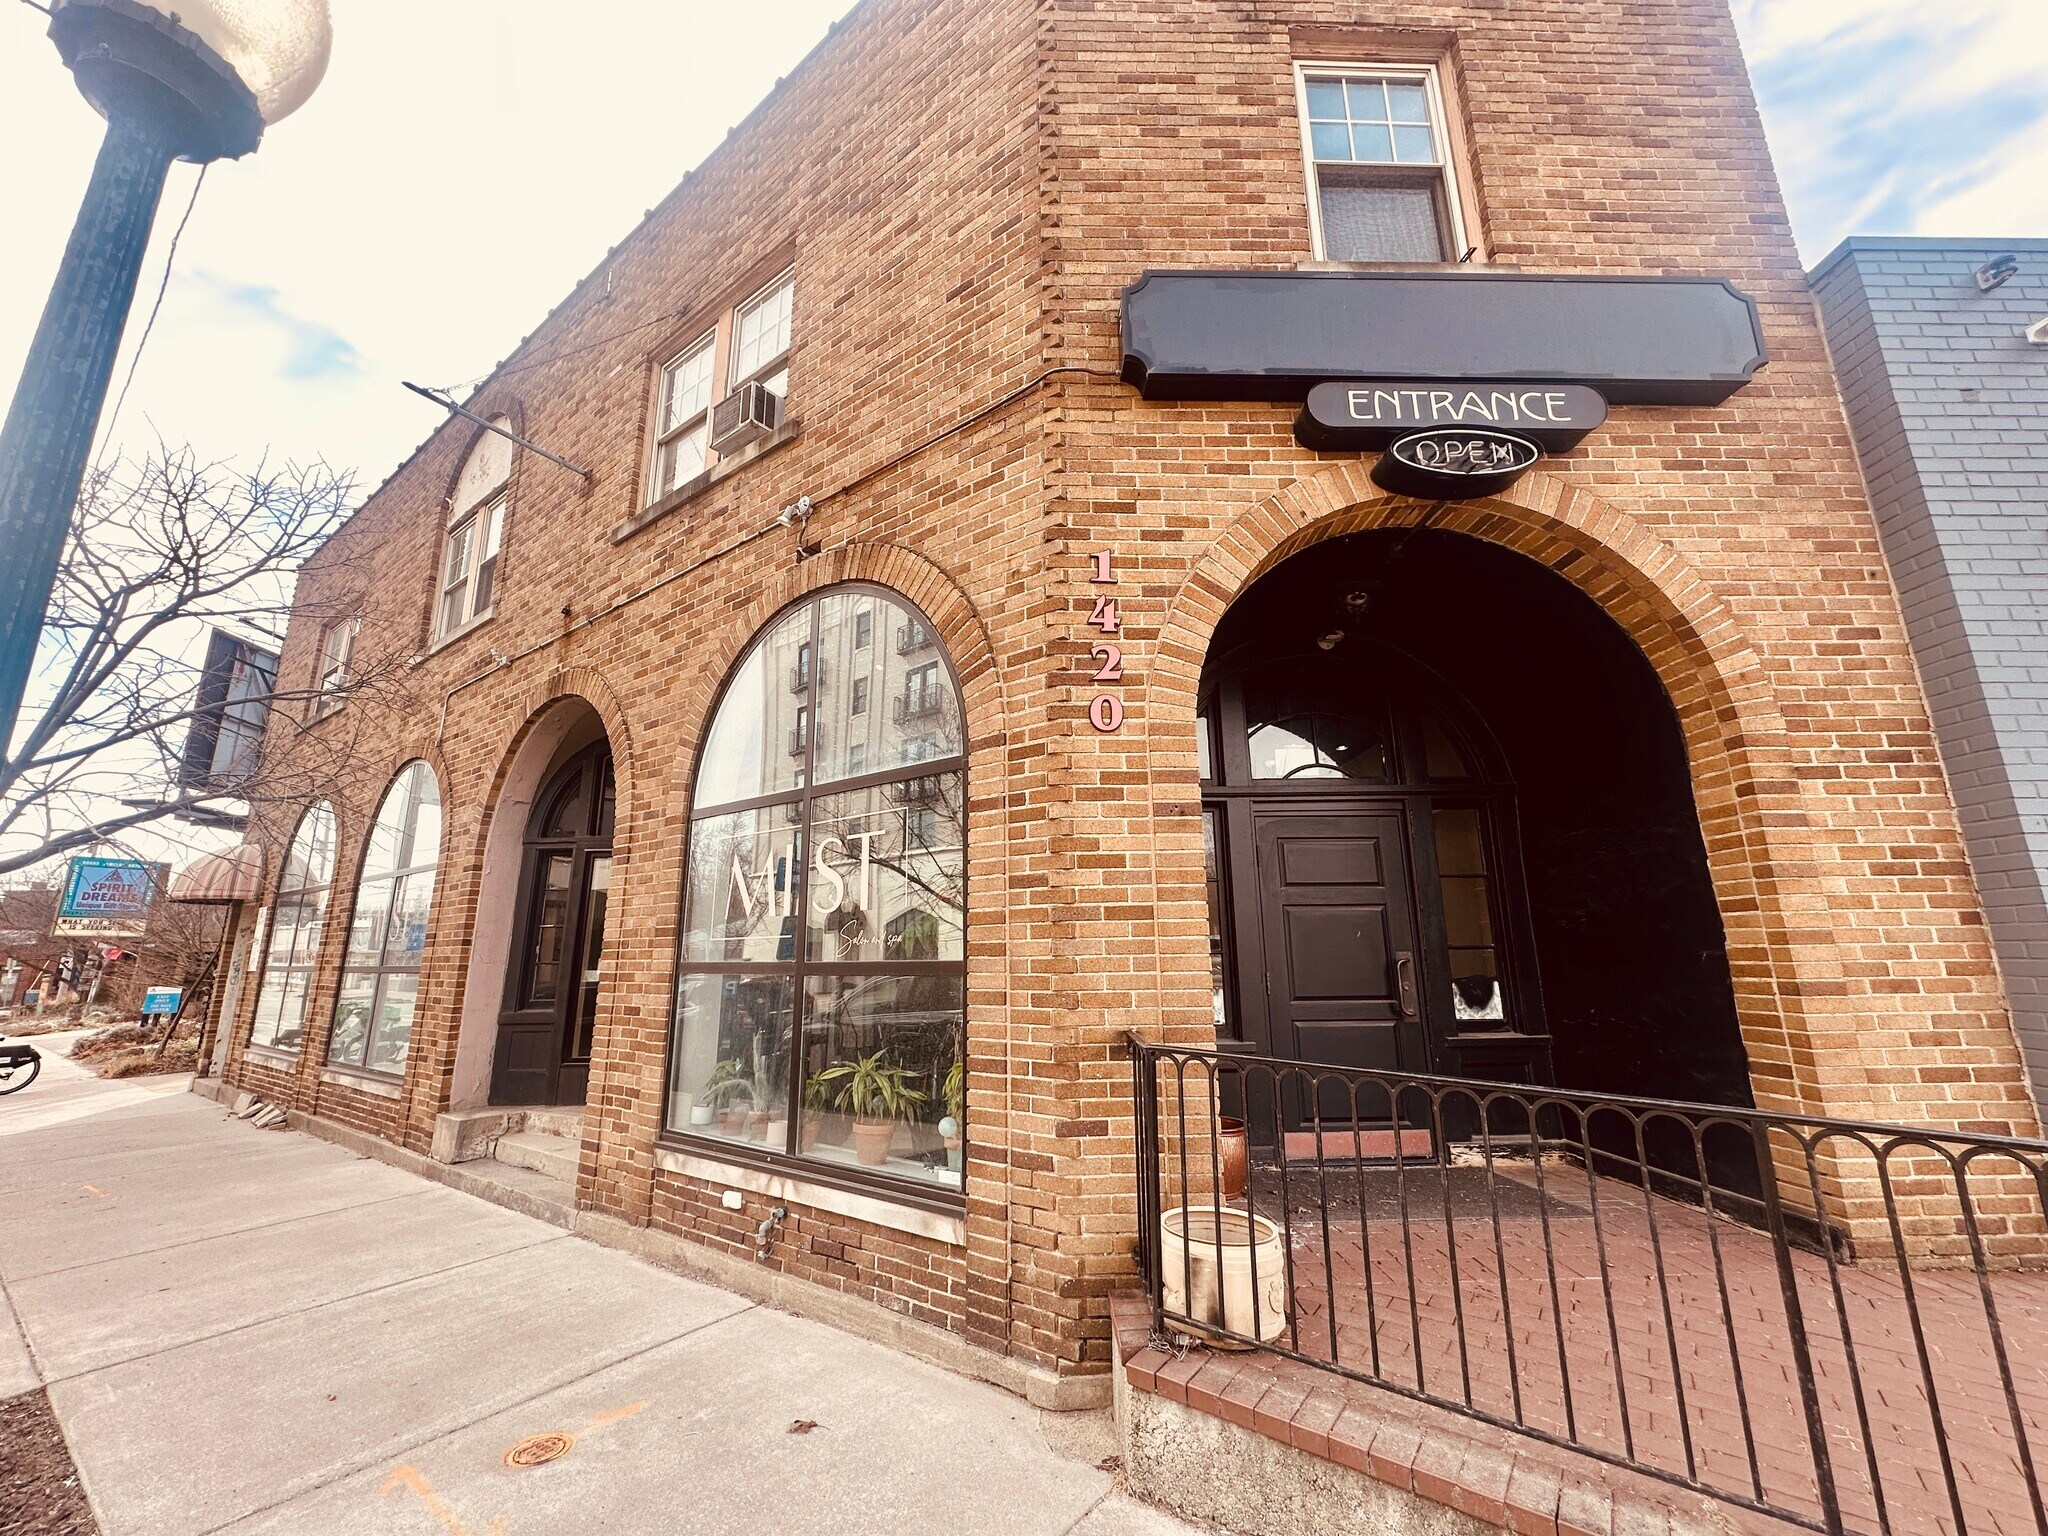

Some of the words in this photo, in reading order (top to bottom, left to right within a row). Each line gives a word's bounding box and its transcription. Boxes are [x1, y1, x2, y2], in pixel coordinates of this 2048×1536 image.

[1347, 390, 1572, 421] ENTRANCE
[1415, 440, 1515, 466] OPEN
[1088, 549, 1124, 732] 1420
[90, 882, 133, 893] SPIRIT
[725, 829, 886, 919] MIST
[75, 901, 102, 909] Unique
[103, 901, 117, 909] Gift
[81, 891, 138, 903] DREAMS
[836, 919, 869, 957] Salon
[887, 934, 903, 947] spa
